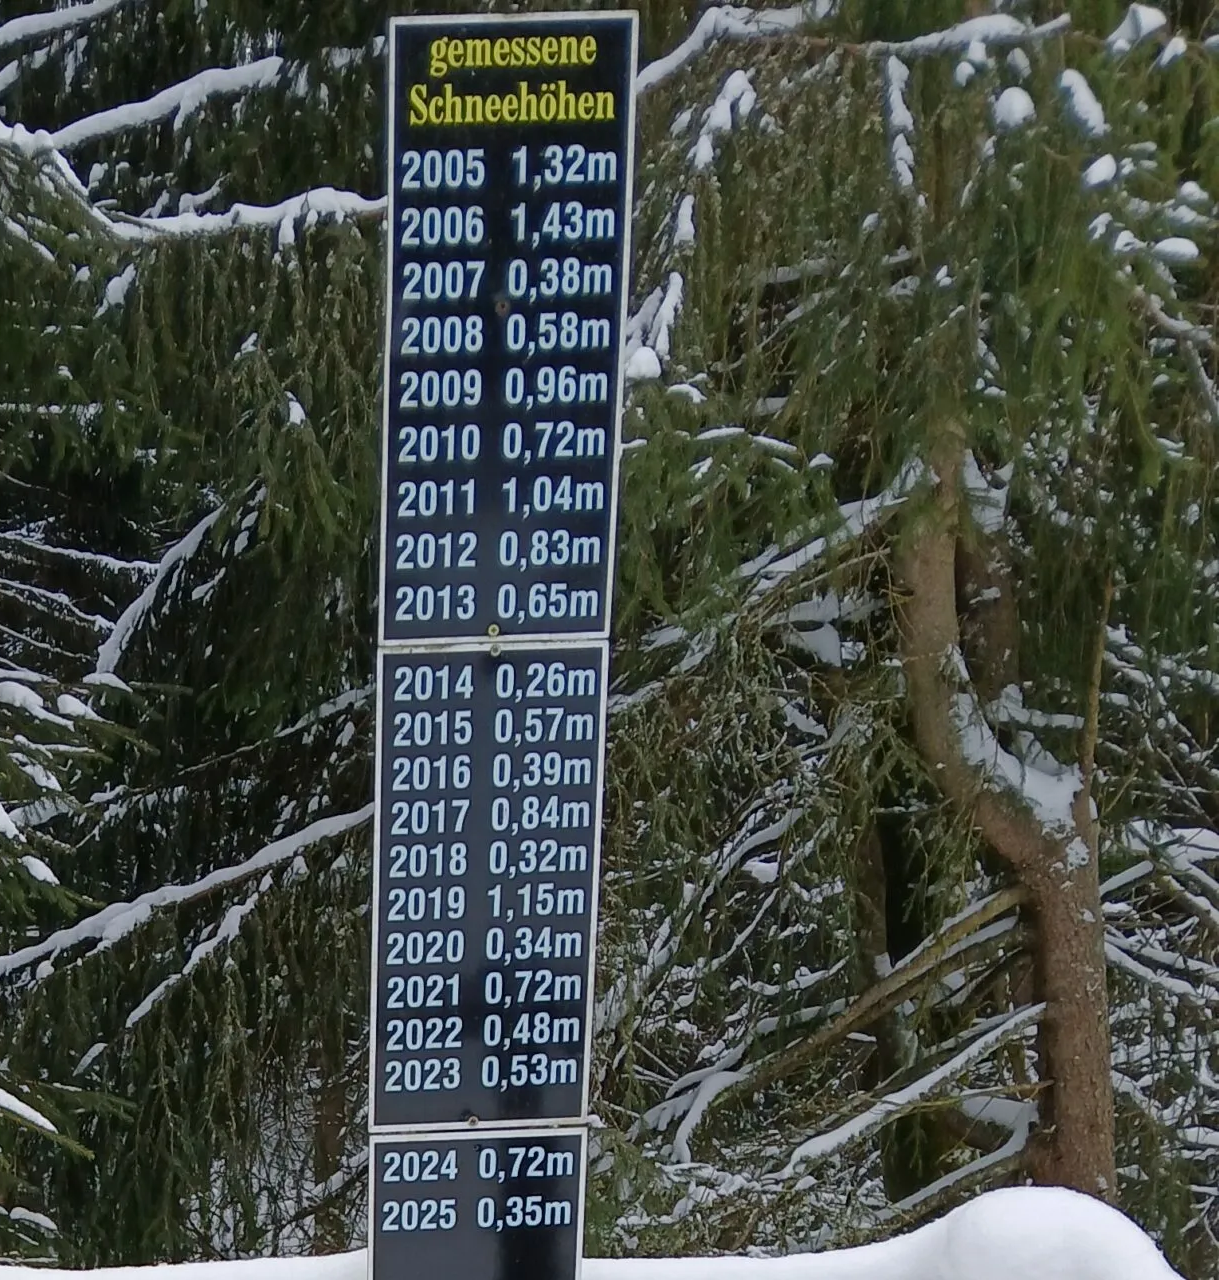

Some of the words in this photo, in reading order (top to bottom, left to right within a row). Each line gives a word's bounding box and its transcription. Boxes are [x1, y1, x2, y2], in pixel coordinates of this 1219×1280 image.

[430, 34, 597, 77] gemessene
[409, 81, 615, 125] Schneehöhen
[402, 148, 485, 189] 2005
[512, 144, 617, 192] 1,32m
[401, 206, 484, 245] 2006
[510, 202, 615, 248] 1,43m
[402, 261, 485, 301] 2007
[508, 257, 613, 303] 0,38m
[401, 315, 482, 354] 2008
[506, 312, 610, 358] 0,58m
[399, 369, 481, 408] 2009
[505, 366, 608, 411] 0,96m
[398, 424, 481, 463] 2010
[502, 421, 606, 465] 0,72m
[397, 478, 475, 517] 2011
[502, 476, 604, 519] 1,04m
[396, 532, 477, 569] 2012
[499, 530, 601, 572] 0,83m
[395, 584, 475, 621] 2013
[497, 583, 598, 624] 0,65m
[394, 665, 473, 701] 2014
[495, 662, 597, 703] 0,26m
[393, 710, 473, 747] 2015
[495, 707, 594, 747] 0,57m
[392, 755, 471, 791] 2016
[493, 752, 592, 792] 0,39m
[391, 799, 470, 835] 2017
[491, 796, 590, 836] 0,84m
[389, 842, 467, 878] 2018
[489, 839, 587, 879] 0,32m
[387, 886, 466, 922] 2019
[487, 883, 585, 923] 1,15m
[386, 930, 465, 965] 2020
[485, 927, 581, 966] 0,34m
[386, 974, 460, 1009] 2021
[484, 969, 581, 1008] 0,72m
[386, 1017, 463, 1051] 2022
[483, 1012, 580, 1050] 0,48m
[385, 1057, 461, 1092] 2023
[482, 1053, 578, 1092] 0,53m
[383, 1150, 458, 1182] 2024
[478, 1146, 574, 1184] 0,72m
[382, 1199, 457, 1231] 2025
[477, 1196, 571, 1232] 0,35m
